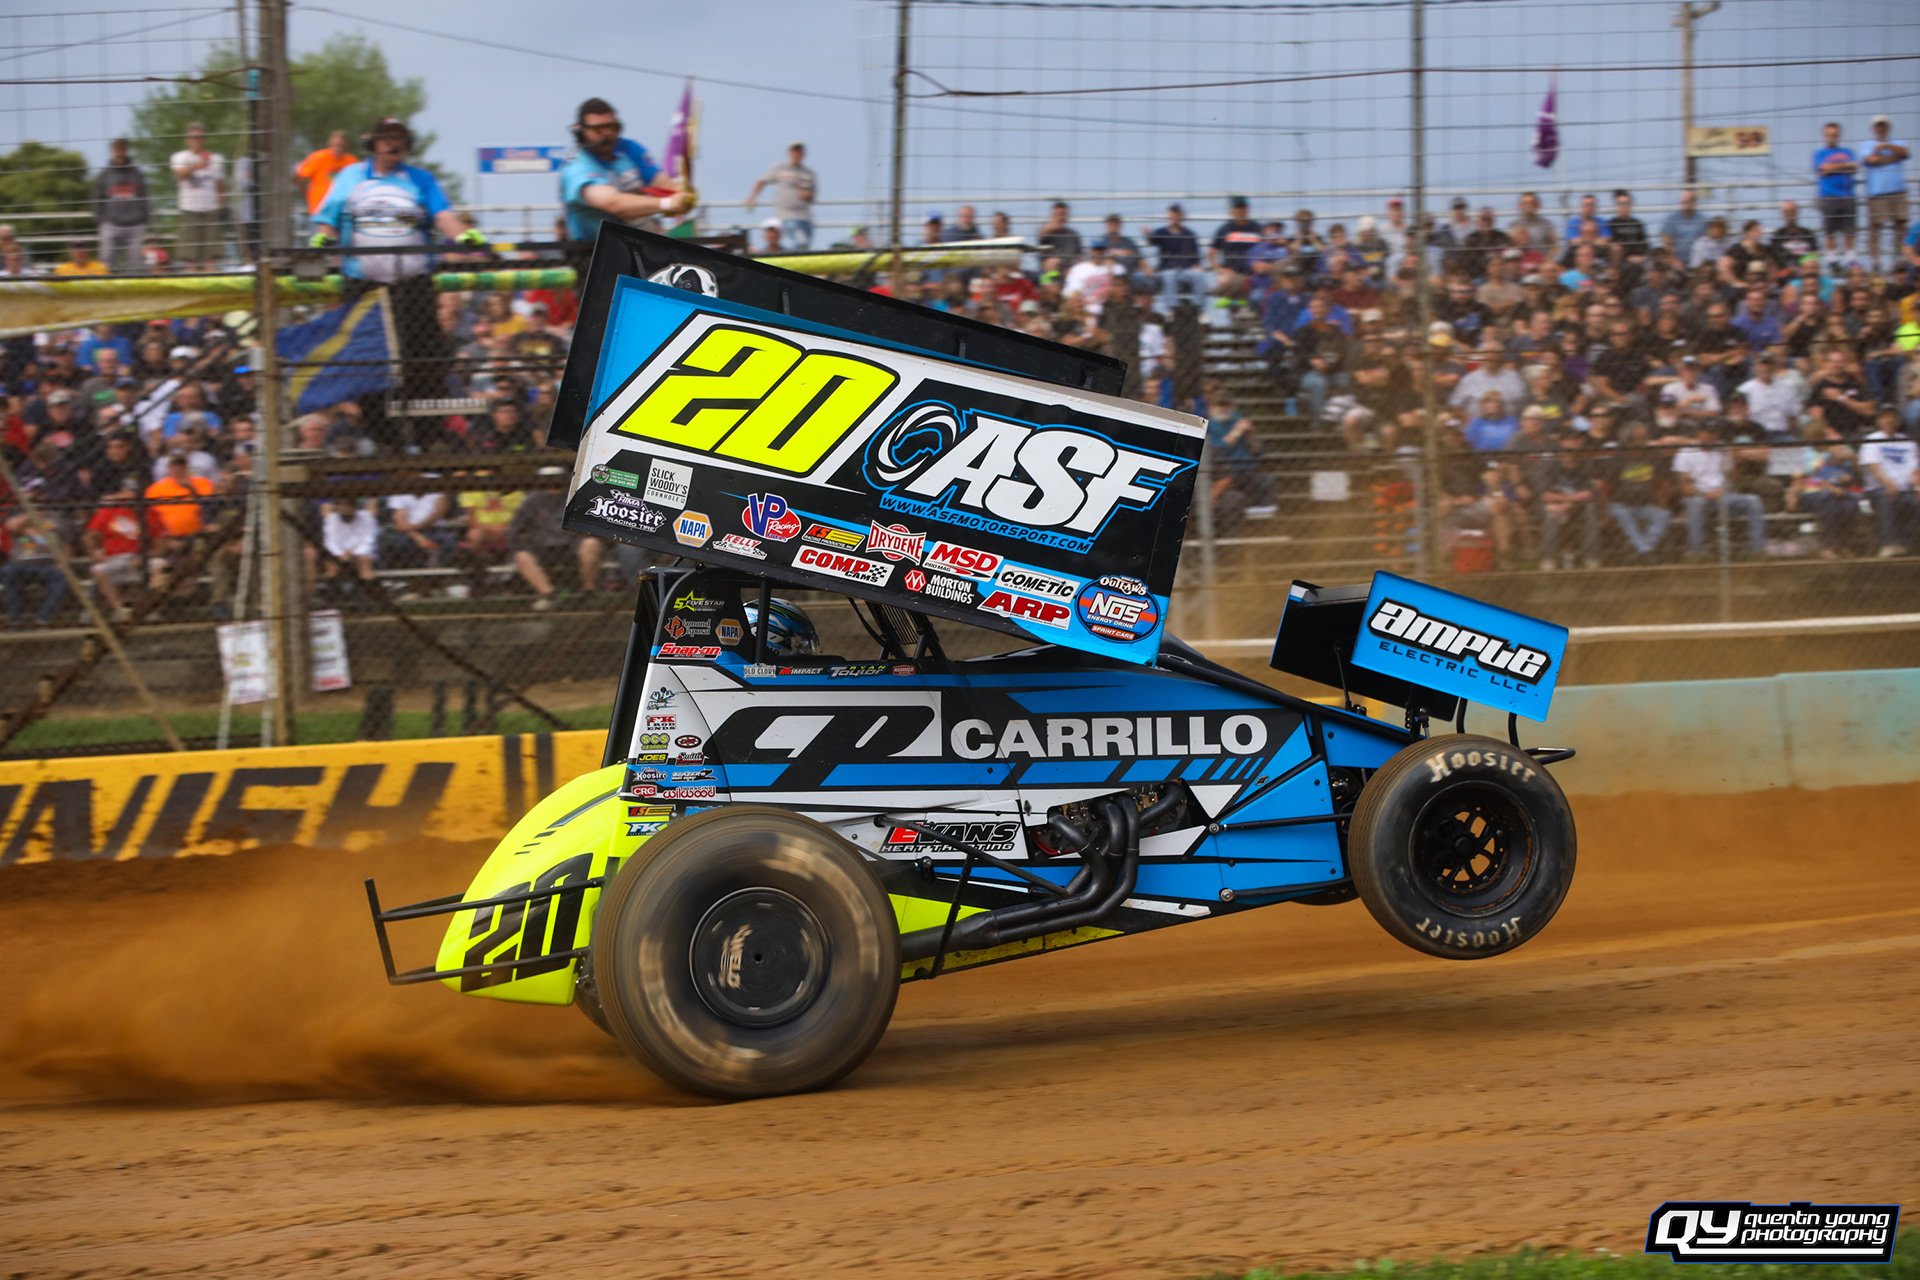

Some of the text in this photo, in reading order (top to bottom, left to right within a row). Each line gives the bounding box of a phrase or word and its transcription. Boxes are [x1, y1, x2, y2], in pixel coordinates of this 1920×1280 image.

[612, 326, 898, 476] 20
[651, 467, 676, 481] SLICK
[905, 416, 1183, 533] ASF
[649, 477, 688, 495] WOODY'S
[646, 490, 679, 503] CORNHOLE
[590, 497, 664, 527] Hoosier
[748, 493, 788, 538] VP
[608, 517, 656, 532] RACING TIRE
[679, 518, 706, 539] NAPA
[767, 520, 799, 534] Racing
[807, 525, 831, 539] KS
[881, 497, 1094, 553] WWW.ASFMOTORSPORT.COM
[725, 534, 761, 548] KELLY
[867, 524, 925, 560] DRYDENE
[800, 549, 871, 574] COMP
[930, 543, 998, 572] MSD
[844, 570, 879, 583] CAMS
[930, 574, 972, 593] MORTON
[1001, 571, 1075, 597] COMETIC
[925, 583, 973, 605] BUILDINGS
[982, 591, 1070, 622] ARP
[1088, 592, 1150, 624] NOS
[1086, 614, 1135, 629] ENERGY DRINK
[721, 625, 739, 638] NAPA
[1092, 625, 1134, 639] SPRINT CARS
[1369, 601, 1548, 678] ample
[659, 643, 721, 657] Snap-on
[830, 666, 883, 678] Taylor
[1379, 641, 1528, 694] ELECTRIC LLC
[642, 735, 668, 743] SCS
[950, 715, 1268, 760] CARRILLO
[633, 787, 656, 795] CRC
[662, 786, 717, 799] wilwood
[629, 806, 648, 816] KS
[629, 823, 662, 833] FK
[887, 822, 1020, 844] EVANS
[460, 852, 594, 993] 20
